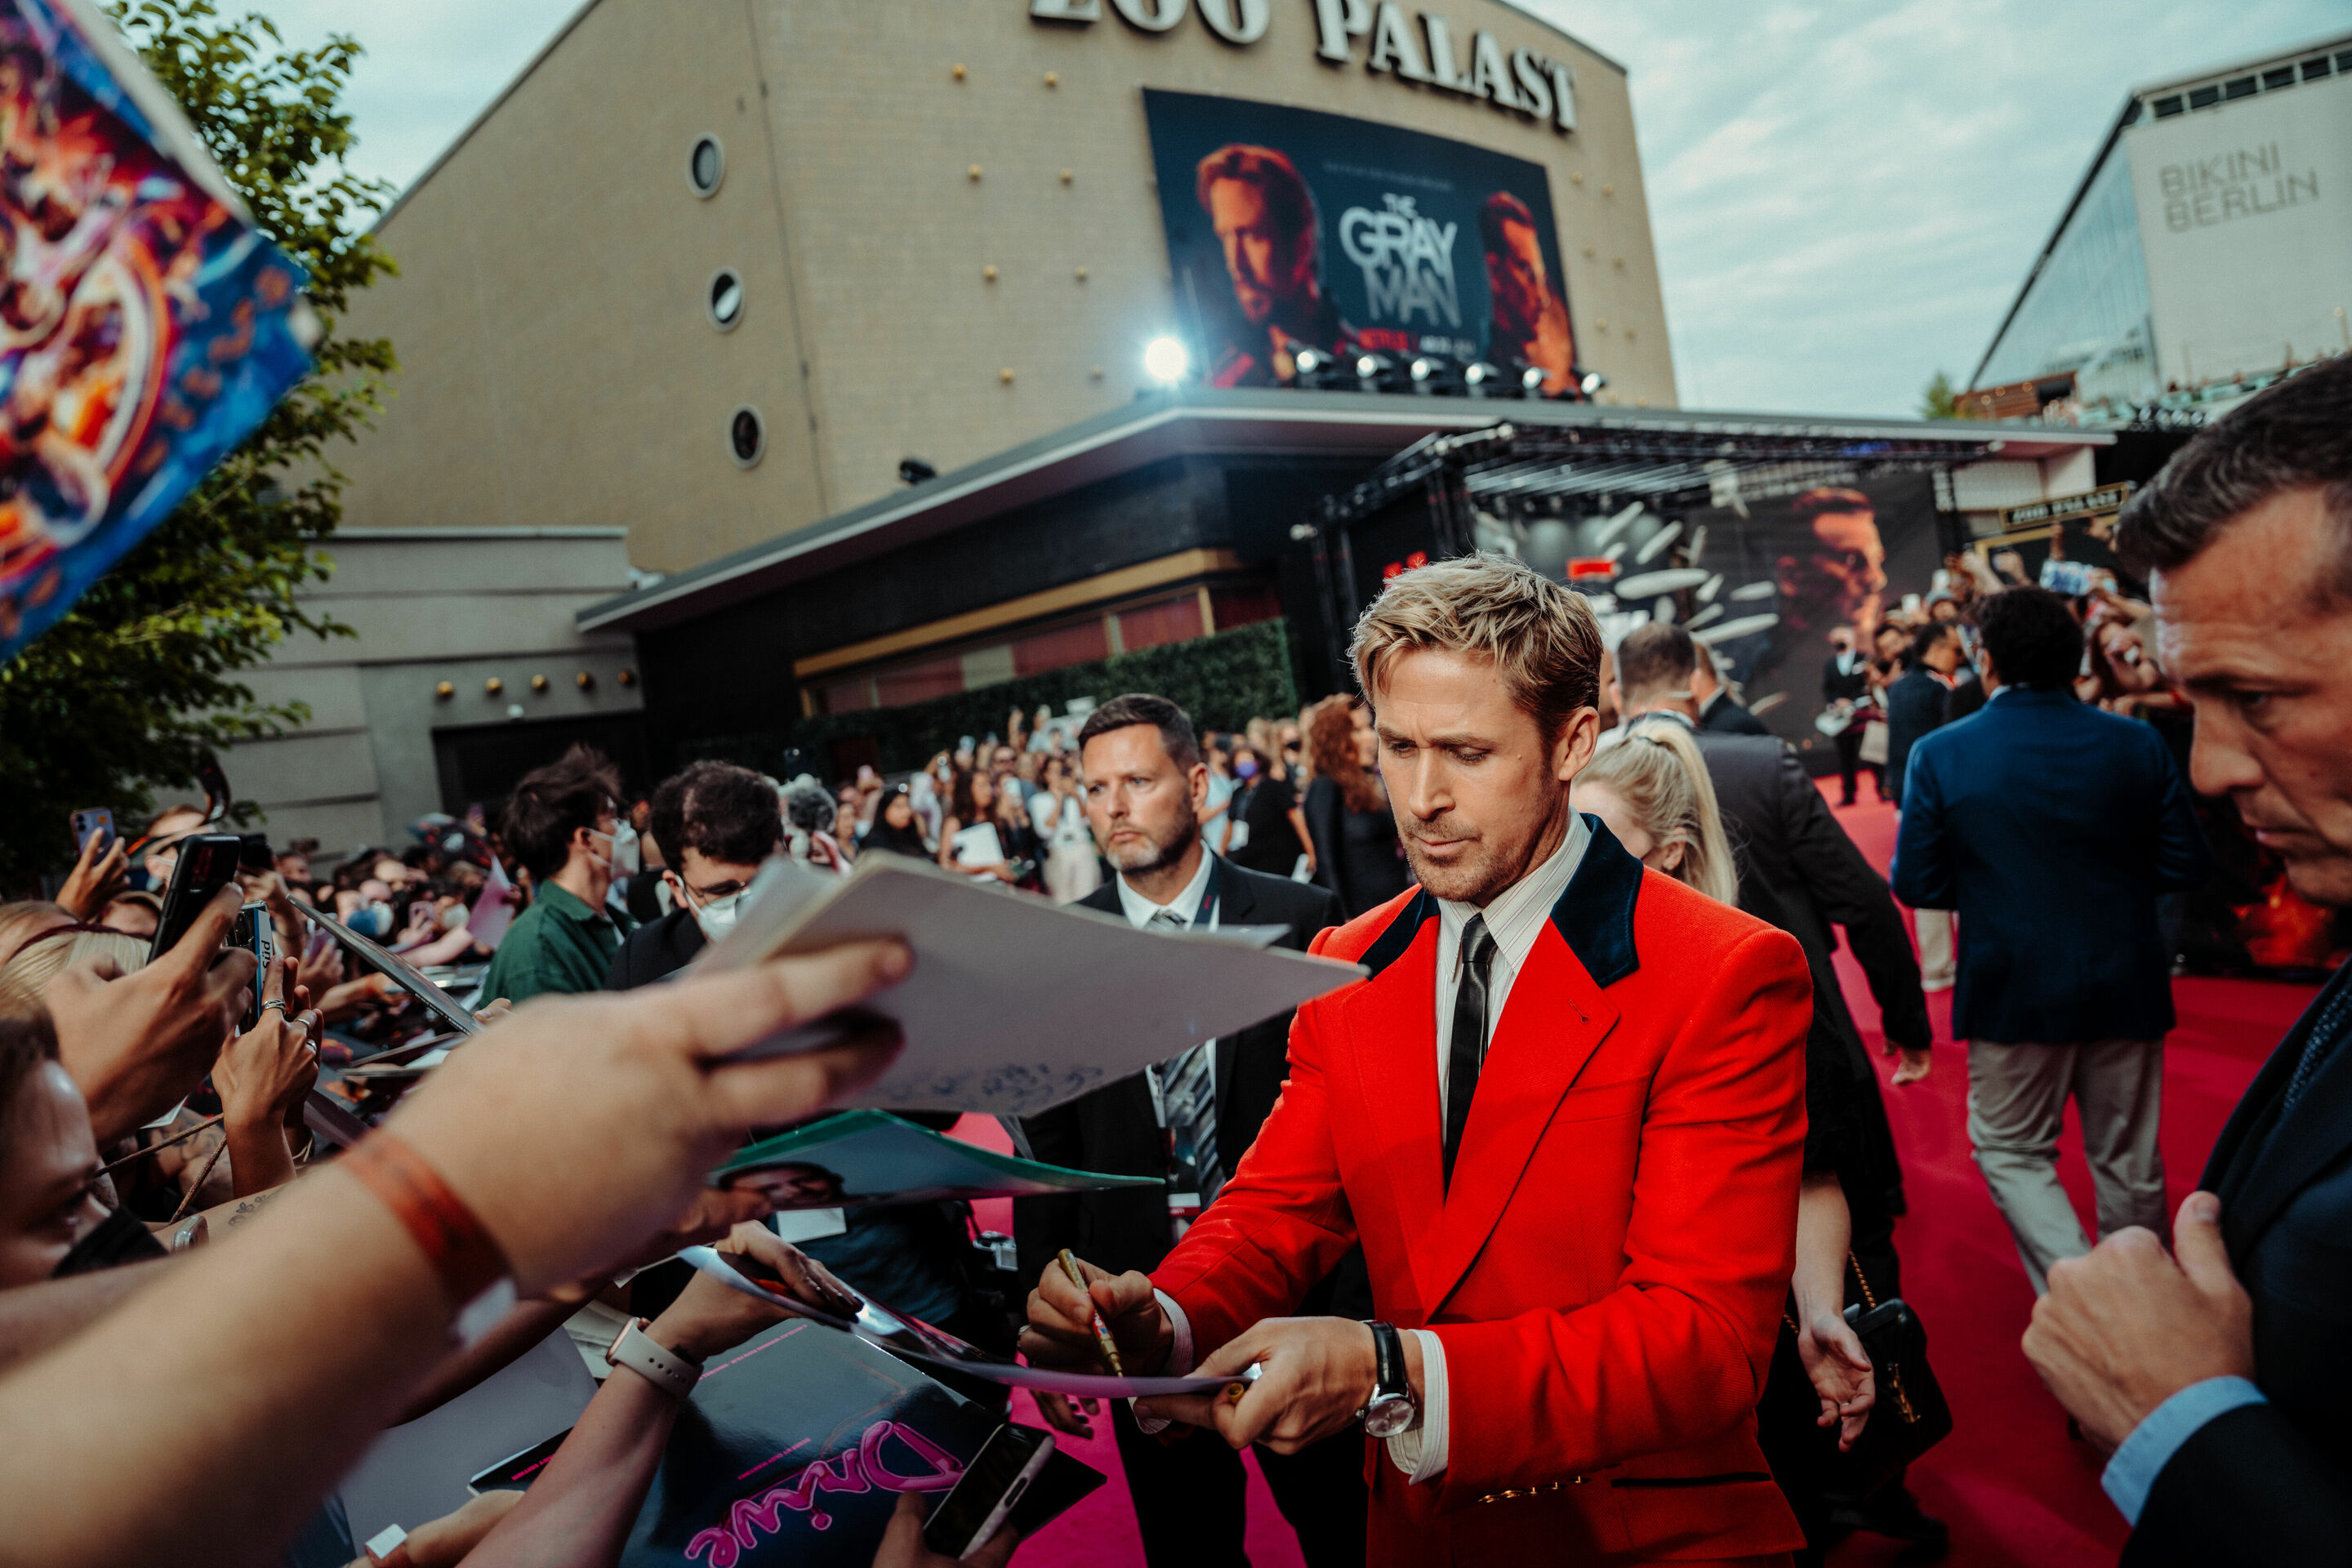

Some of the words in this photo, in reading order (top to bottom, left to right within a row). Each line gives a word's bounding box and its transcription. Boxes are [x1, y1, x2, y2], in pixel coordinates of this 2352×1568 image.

[1316, 0, 1576, 131] PALAST
[2159, 140, 2280, 199] BIKINI
[2167, 167, 2319, 234] BERLIN
[1339, 206, 1458, 278] GRAY
[1363, 263, 1462, 328] MAN
[684, 1420, 964, 1568] Drive
